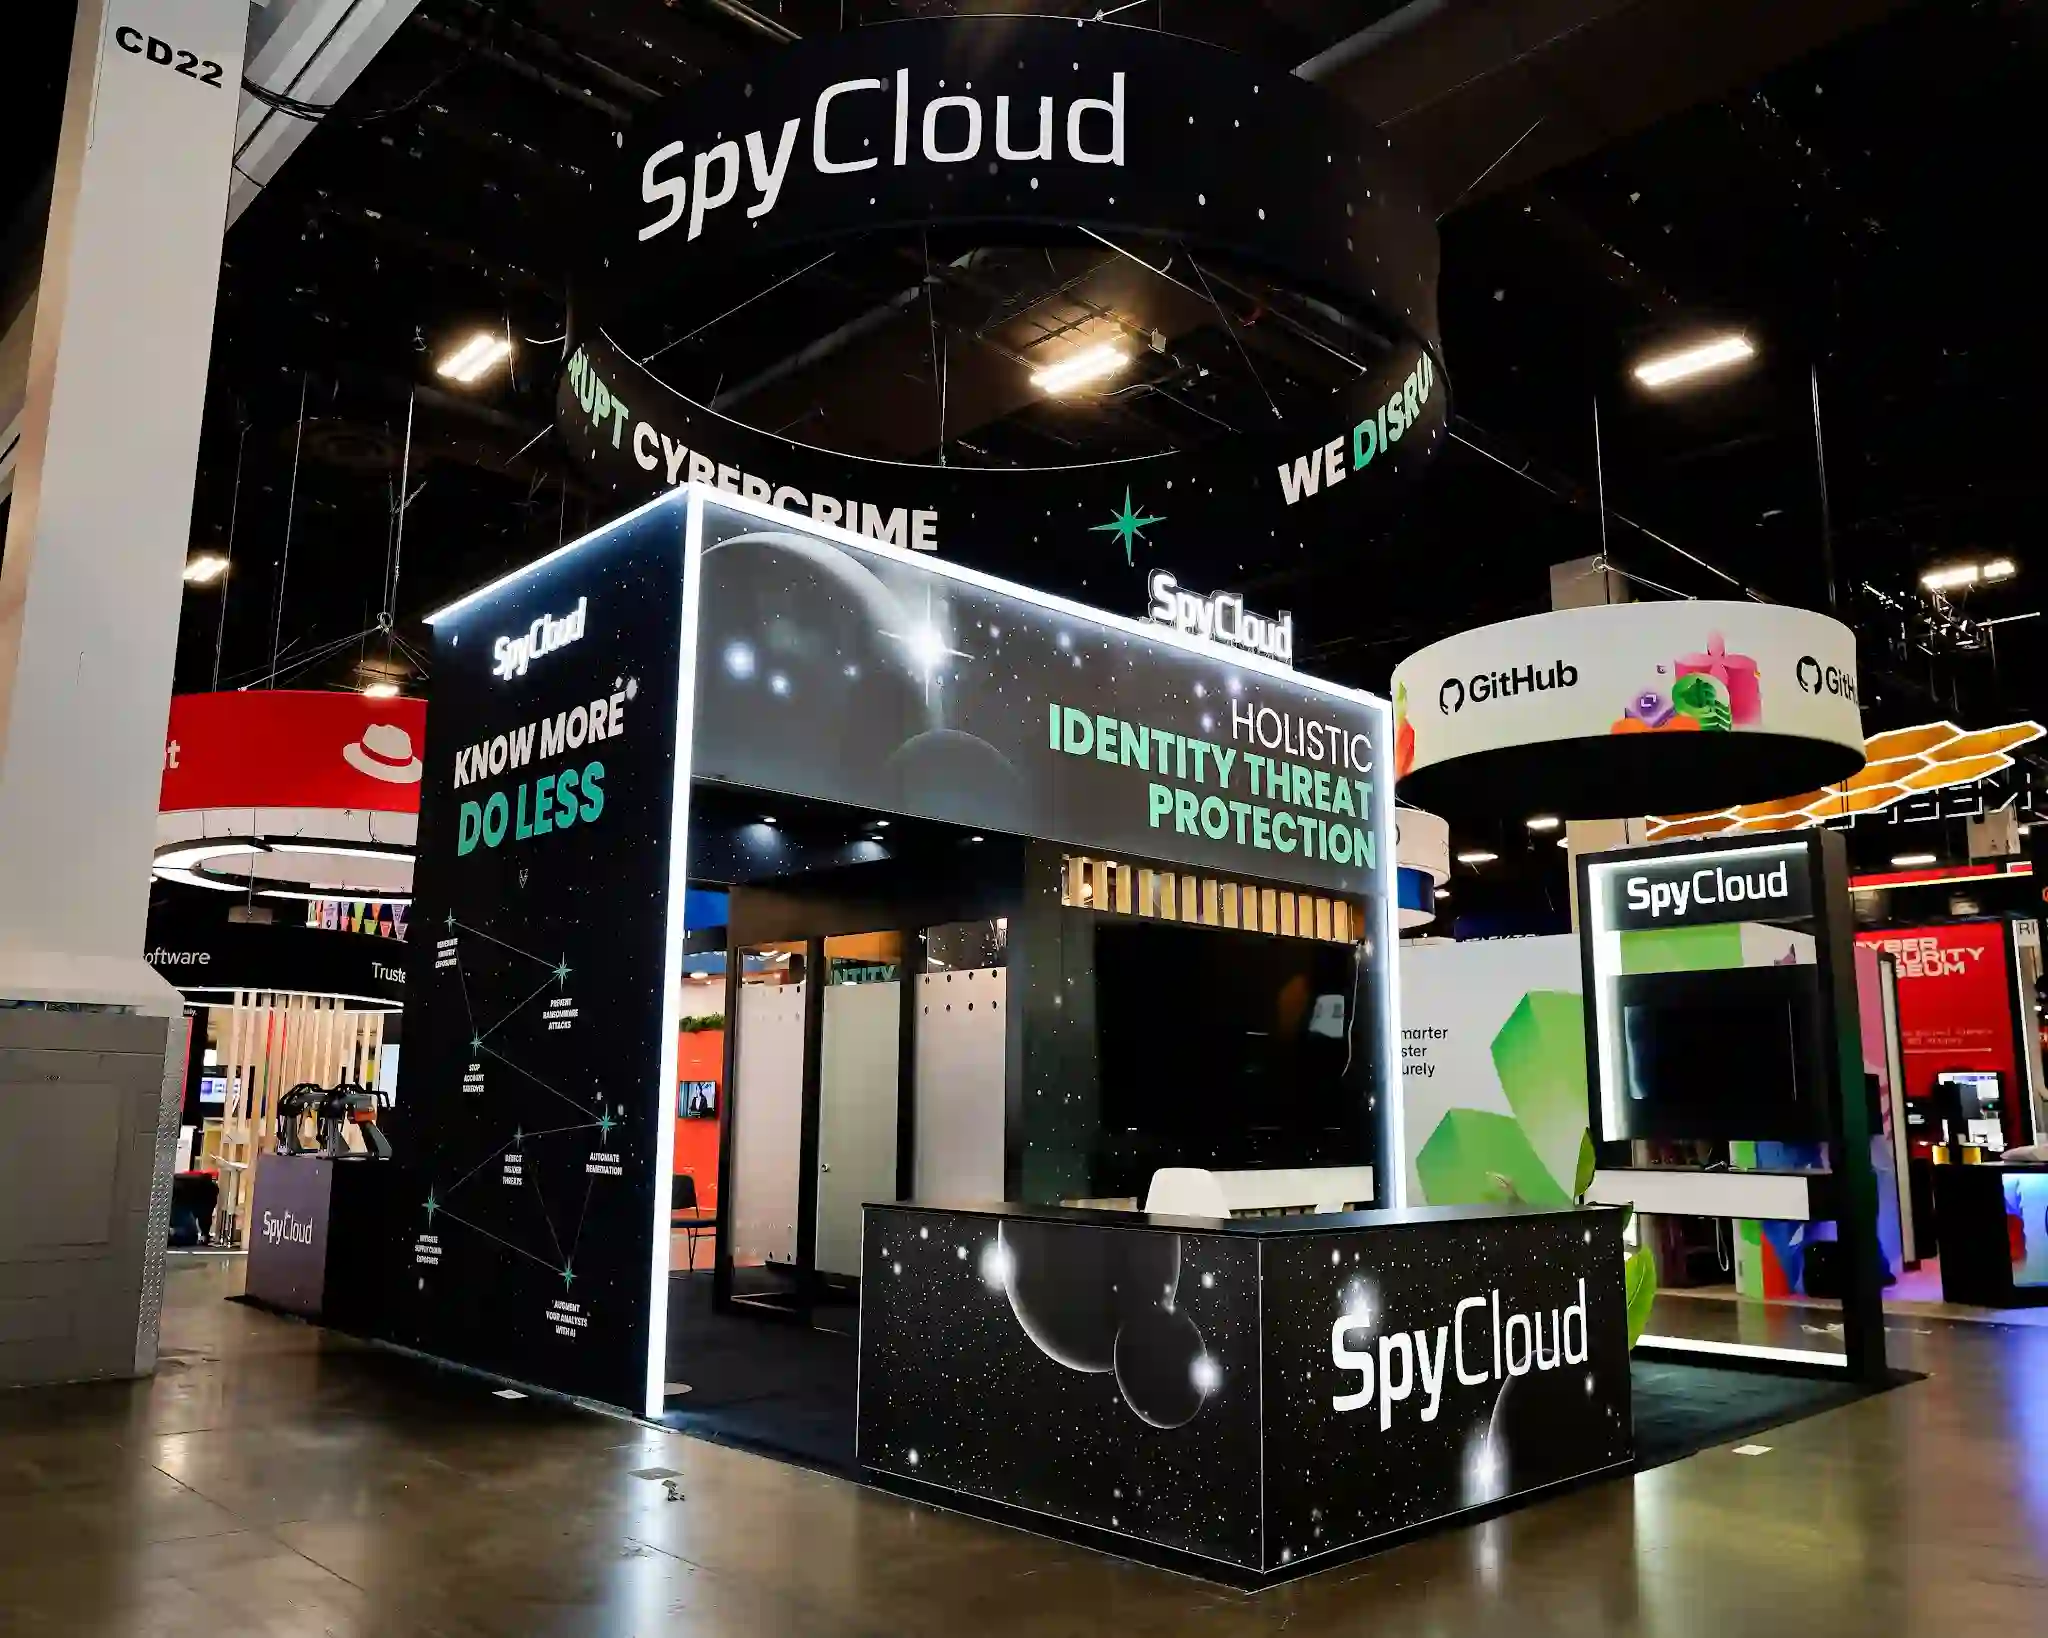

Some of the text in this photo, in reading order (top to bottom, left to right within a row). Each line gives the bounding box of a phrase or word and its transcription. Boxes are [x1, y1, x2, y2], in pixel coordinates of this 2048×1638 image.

[115, 25, 224, 88] CD22
[638, 68, 1126, 241] SpyCloud
[1278, 351, 1434, 505] WE DISRU
[633, 421, 938, 550] CYBERCRIME
[492, 596, 587, 681] SpyCloud
[1149, 571, 1292, 662] SpyCloud
[1469, 659, 1578, 702] GitHub
[1825, 666, 1856, 704] GitH
[454, 690, 625, 789] KNOW MORE
[1049, 704, 1373, 820] IDENTITY THREAT
[1232, 698, 1373, 773] HOLISTIC
[458, 761, 604, 856] DO LESS
[1150, 783, 1376, 869] PROTECTION
[1627, 861, 1788, 917] SpyCloud
[143, 946, 211, 965] oftware
[371, 961, 406, 984] Truste
[832, 964, 896, 984] NTITY
[1401, 1025, 1448, 1040] marter
[1401, 1044, 1427, 1058] ster
[1402, 1062, 1435, 1078] urely
[585, 1163, 623, 1176] REMEDIATION
[589, 1152, 621, 1163] AUTOMATE
[262, 1209, 314, 1245] SpyCloud
[1331, 1278, 1590, 1433] SpyCloud
